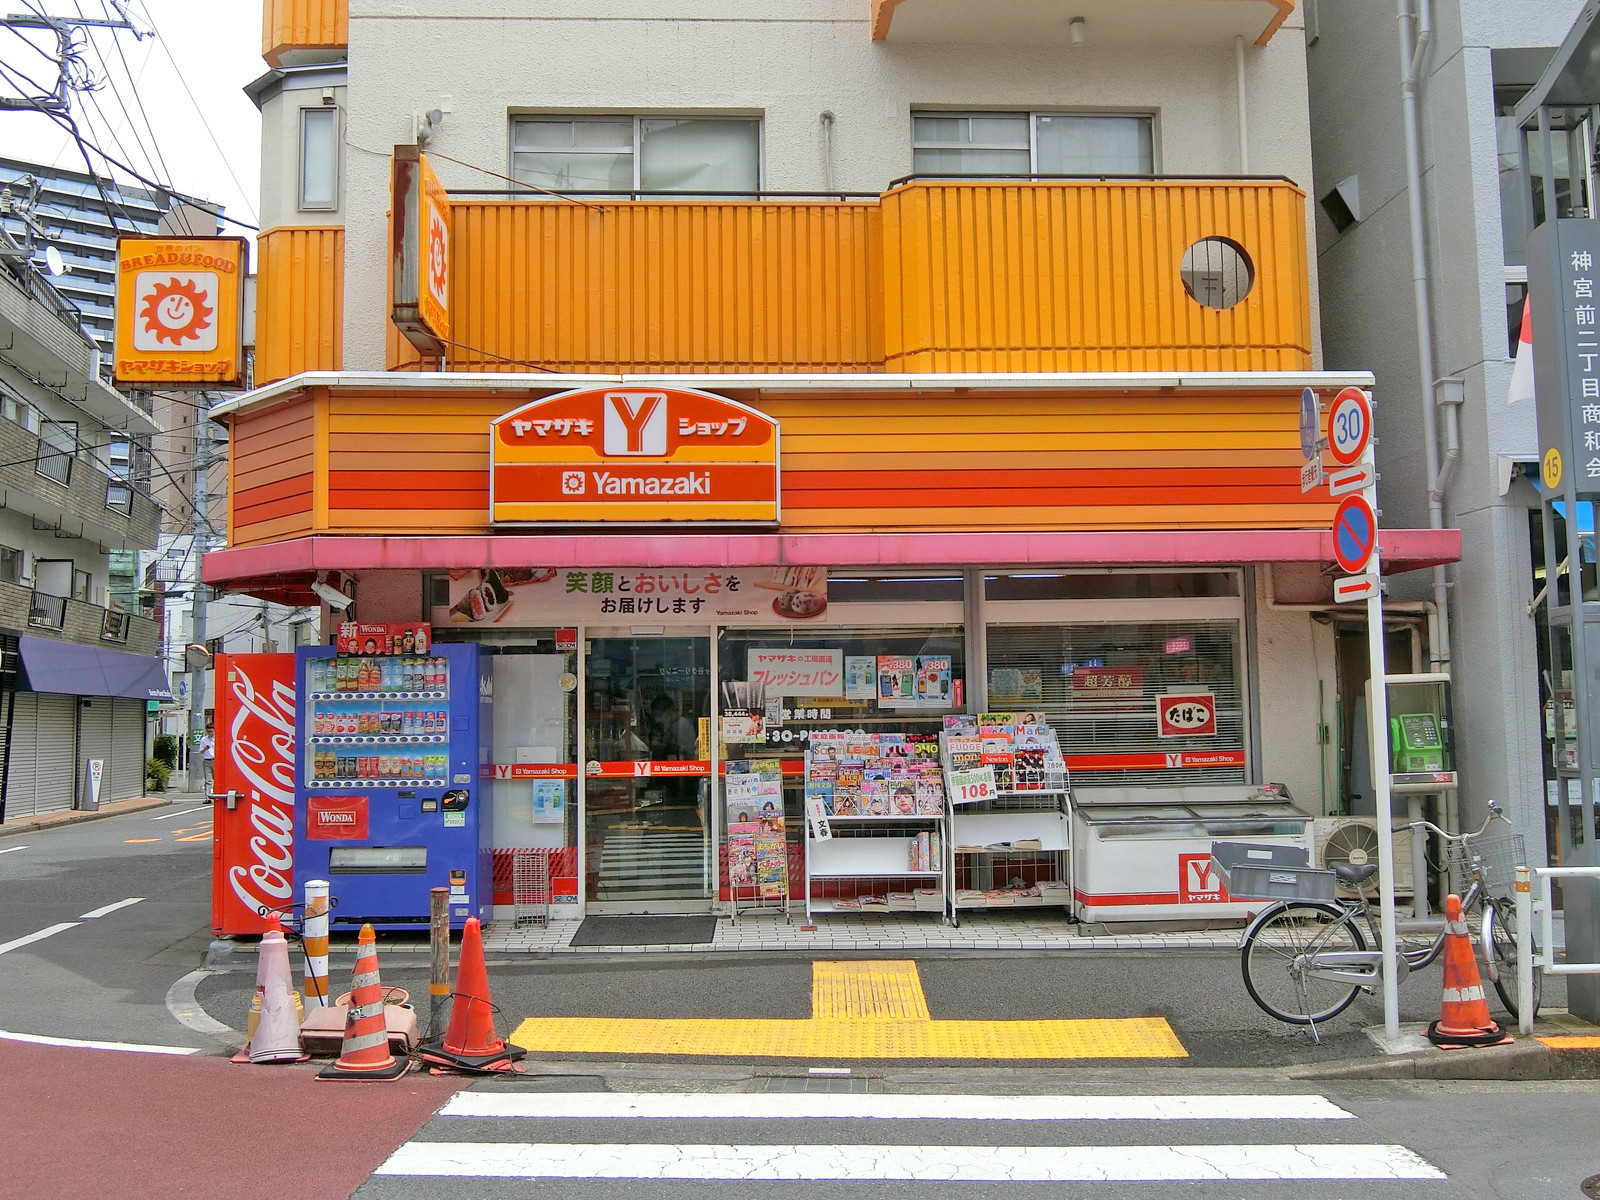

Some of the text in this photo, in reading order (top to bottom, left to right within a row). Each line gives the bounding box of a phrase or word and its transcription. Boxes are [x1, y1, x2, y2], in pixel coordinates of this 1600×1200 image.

[156, 244, 203, 253] 世界のパン
[120, 252, 235, 273] BREAD&FOOD
[120, 359, 232, 374] ヤマザキショップ
[1570, 250, 1600, 478] 神宮前二丁目商和会
[511, 418, 595, 437] ヤマザキ
[609, 396, 662, 452] Y
[678, 416, 748, 437] ショップ
[1337, 408, 1360, 445] 30
[1545, 455, 1559, 479] 15
[592, 471, 711, 496] Yamazaki
[565, 571, 742, 594] 笑顔とおいしさを
[600, 597, 706, 614] お届けします
[744, 609, 759, 617] Shop
[340, 620, 358, 638] 新
[361, 624, 385, 633] WONDA
[752, 670, 840, 686] フレッシュパン
[781, 708, 832, 720] 営業時間
[1169, 707, 1205, 724] たばこ
[949, 743, 981, 751] FUDGE
[1218, 755, 1234, 763] Shop
[550, 767, 567, 776] Shop
[660, 764, 705, 773] Yamazaki Shop
[229, 664, 297, 920] Coca-Cola
[320, 811, 353, 823] WONDA
[553, 894, 578, 903] SECOM
[1188, 893, 1221, 901] ヤマザキ
